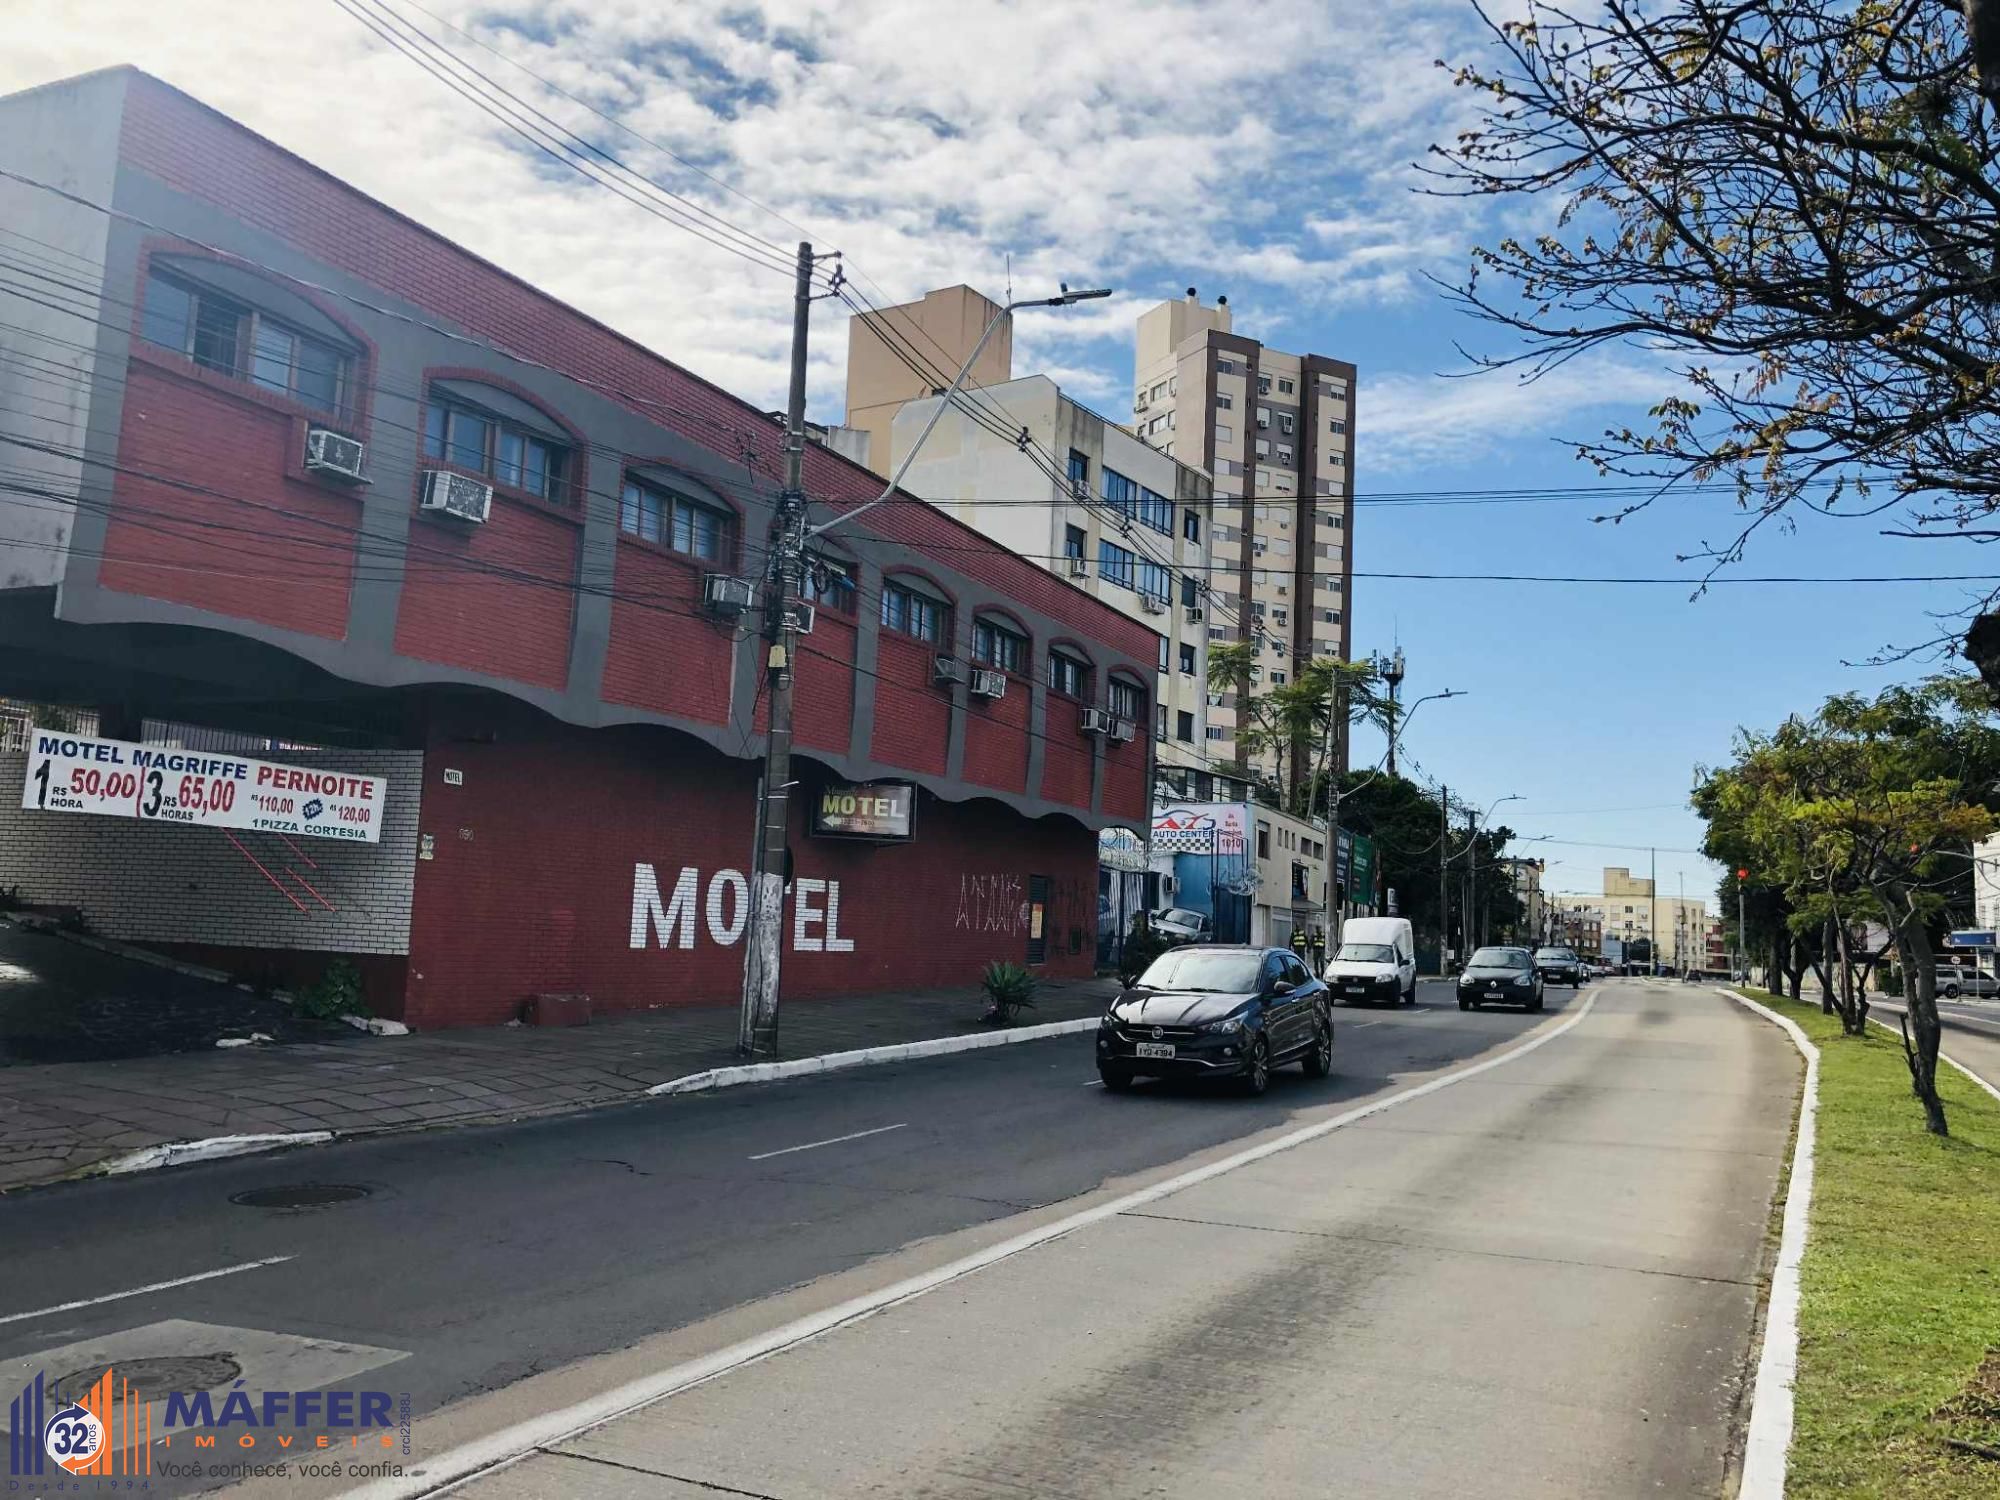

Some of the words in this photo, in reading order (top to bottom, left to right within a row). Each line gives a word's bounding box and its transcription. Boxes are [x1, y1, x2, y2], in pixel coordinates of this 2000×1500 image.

[38, 737, 124, 764] MOTEL
[132, 750, 248, 779] MAGRIFFE
[35, 759, 50, 809] 1
[70, 768, 136, 801] 50,00
[143, 771, 163, 816] 3
[179, 775, 235, 817] 65,00
[257, 766, 374, 800] PERNOITE
[50, 798, 83, 809] HORA
[161, 809, 194, 820] HORAS
[259, 795, 294, 816] 110,00
[338, 806, 370, 825] 120,00
[822, 794, 905, 818] MOTEL
[261, 819, 299, 832] PIZZA
[304, 824, 367, 839] CORTESIA
[1153, 830, 1177, 838] AUTO
[630, 863, 855, 952] MOEL
